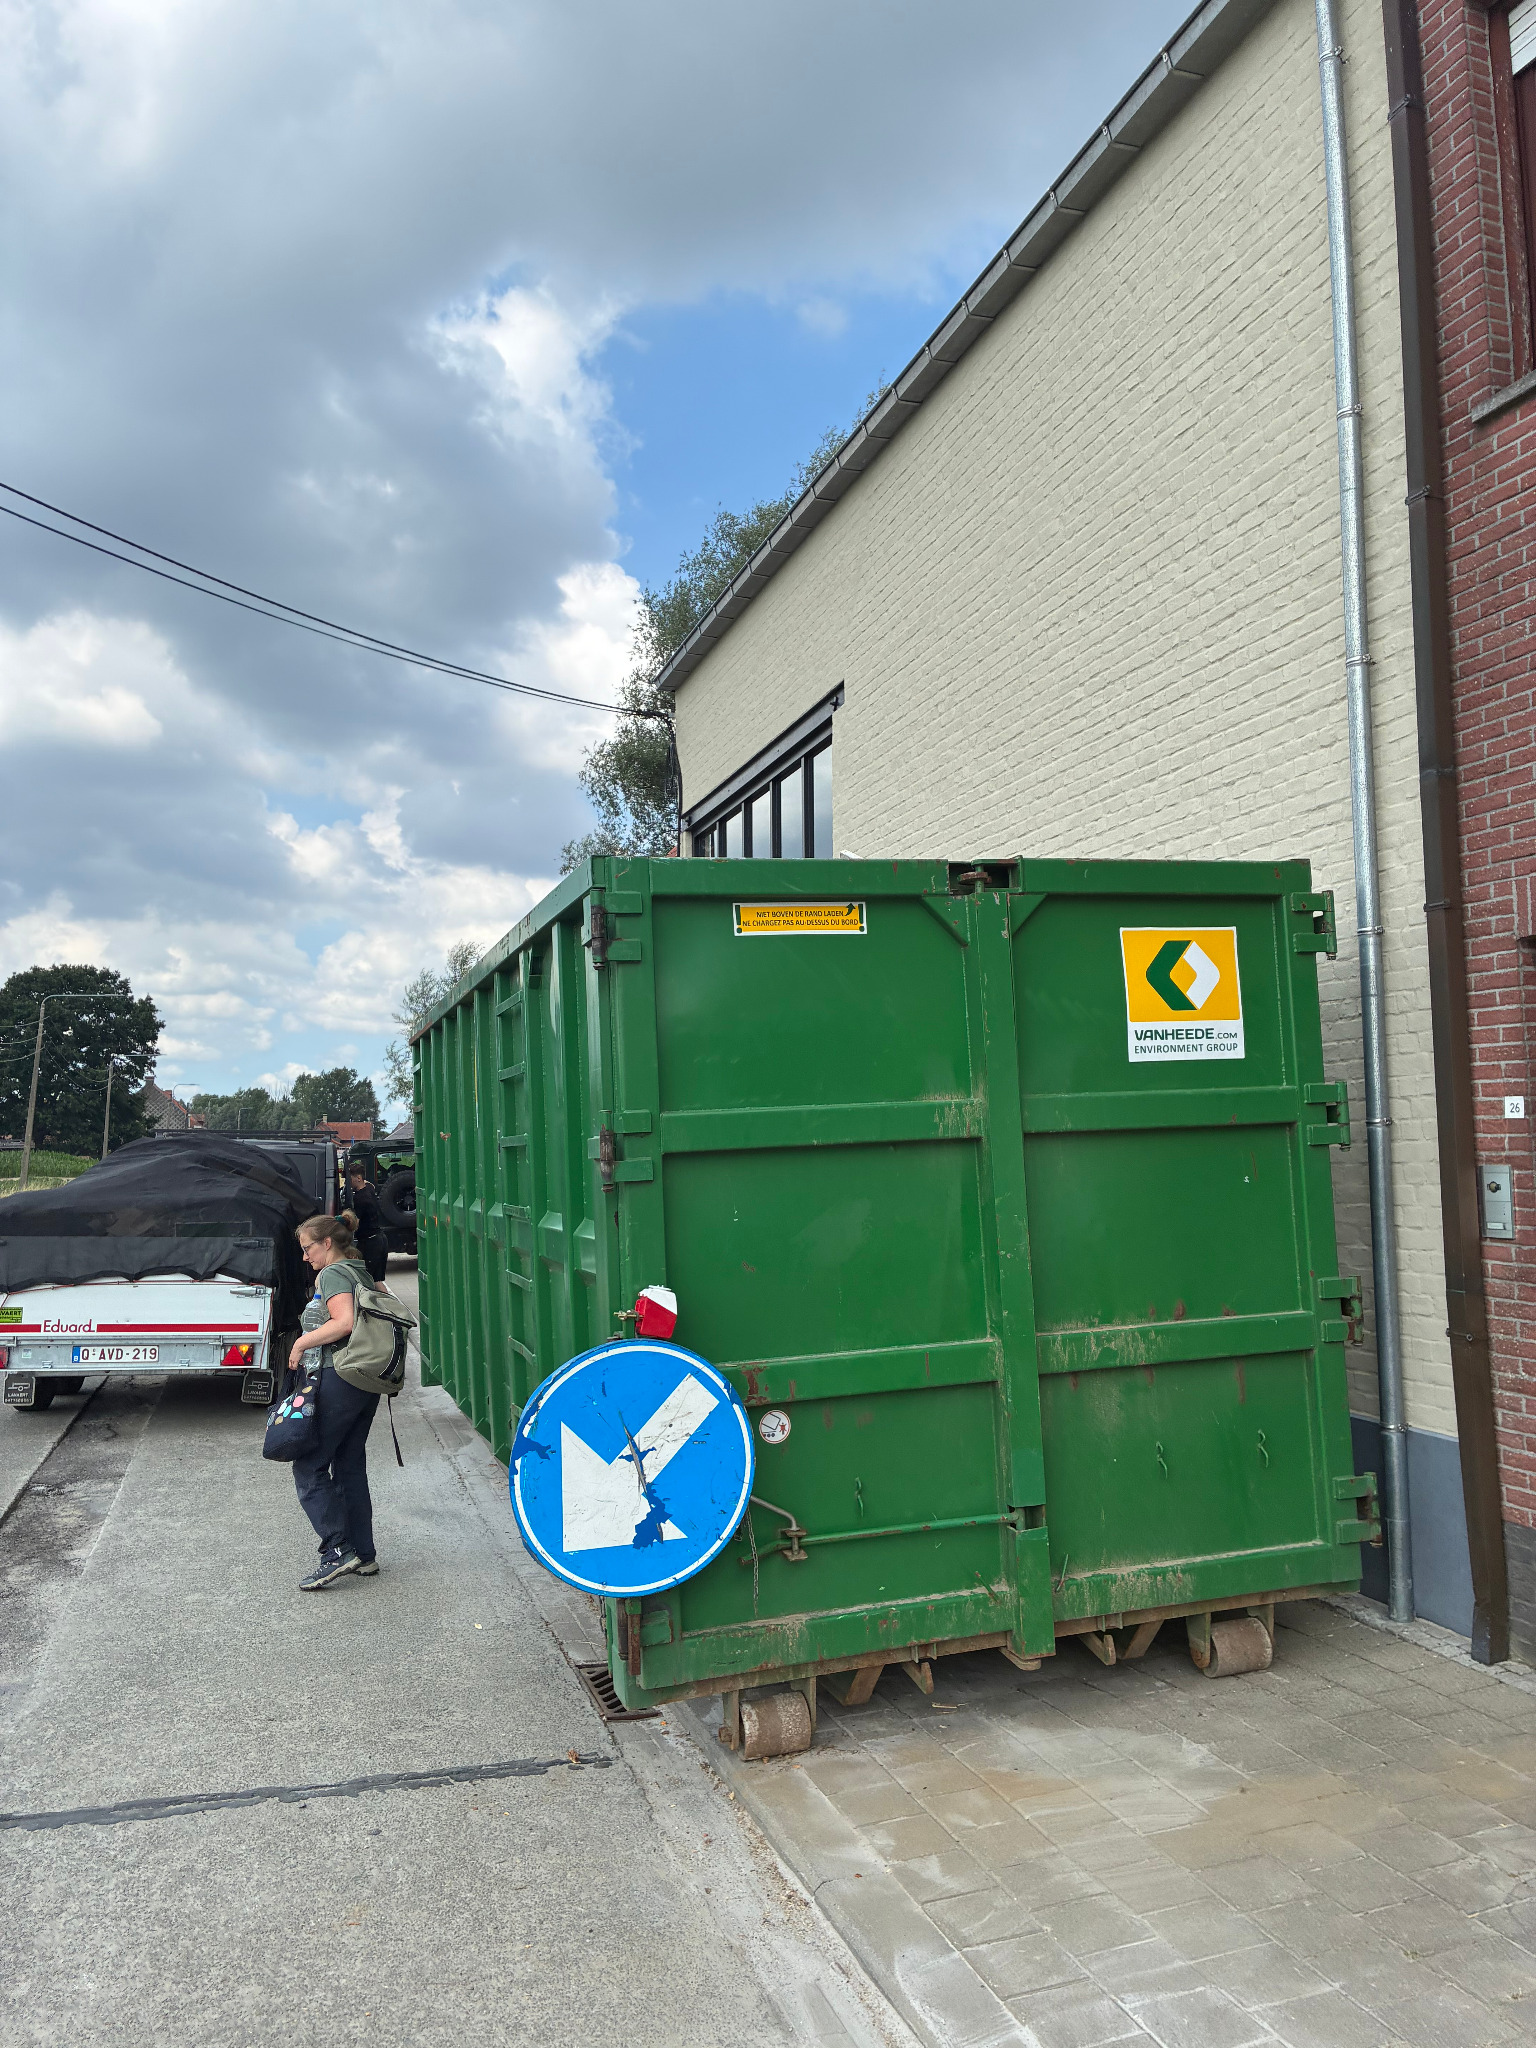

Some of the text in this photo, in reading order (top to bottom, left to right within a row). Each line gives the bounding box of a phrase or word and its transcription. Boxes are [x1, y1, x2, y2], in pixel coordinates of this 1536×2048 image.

[771, 910, 794, 918] BOVEN
[752, 919, 781, 927] CHARGEZ
[830, 918, 840, 926] DU
[841, 918, 859, 926] BORD
[1134, 1042, 1238, 1054] ENVIRONMENT GROUP
[1509, 1102, 1521, 1113] 26
[43, 1318, 96, 1333] Eduard
